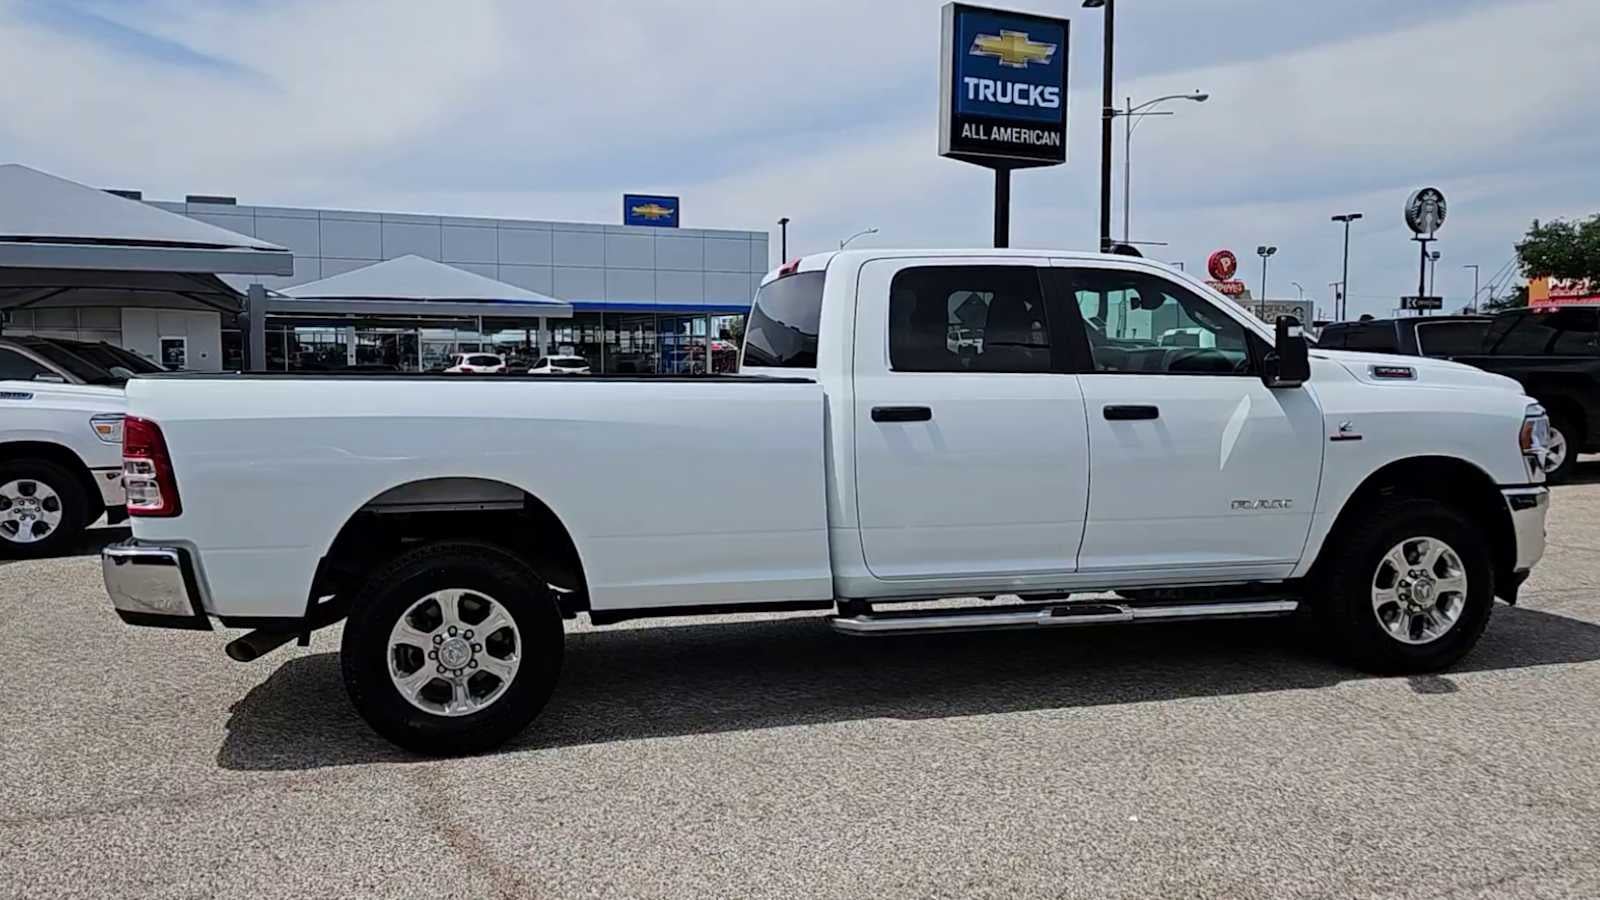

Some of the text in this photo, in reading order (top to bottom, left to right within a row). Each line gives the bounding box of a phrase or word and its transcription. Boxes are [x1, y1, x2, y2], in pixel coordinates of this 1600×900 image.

[964, 76, 1060, 108] TRUCKS
[961, 123, 1060, 147] ALL AMERICAN
[1231, 499, 1293, 511] RAM
